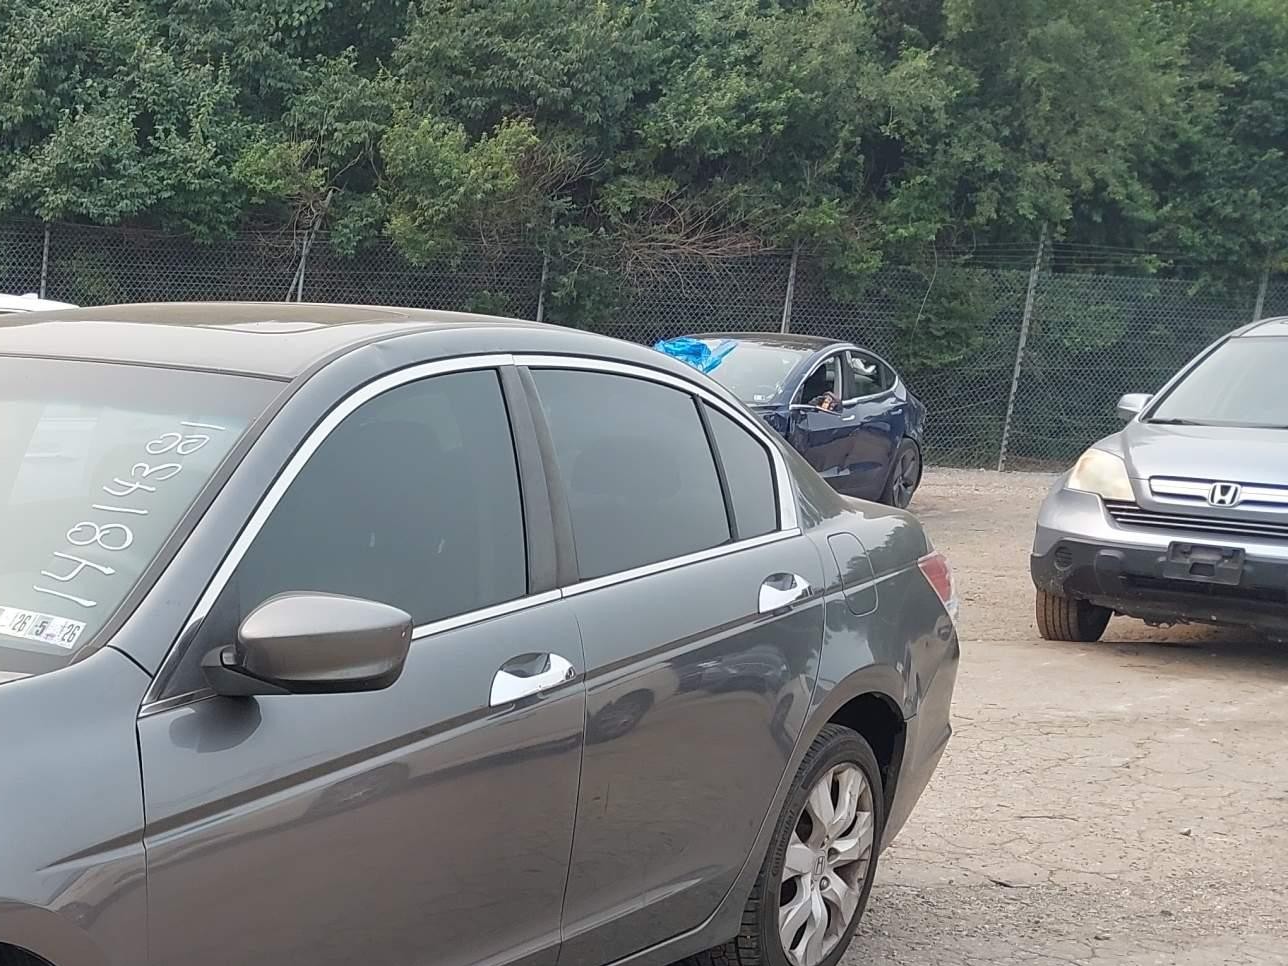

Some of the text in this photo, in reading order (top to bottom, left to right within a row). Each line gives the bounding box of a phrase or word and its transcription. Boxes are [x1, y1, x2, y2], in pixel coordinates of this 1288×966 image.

[33, 421, 226, 607] 14814381
[12, 614, 32, 633] 26
[61, 623, 81, 643] 26
